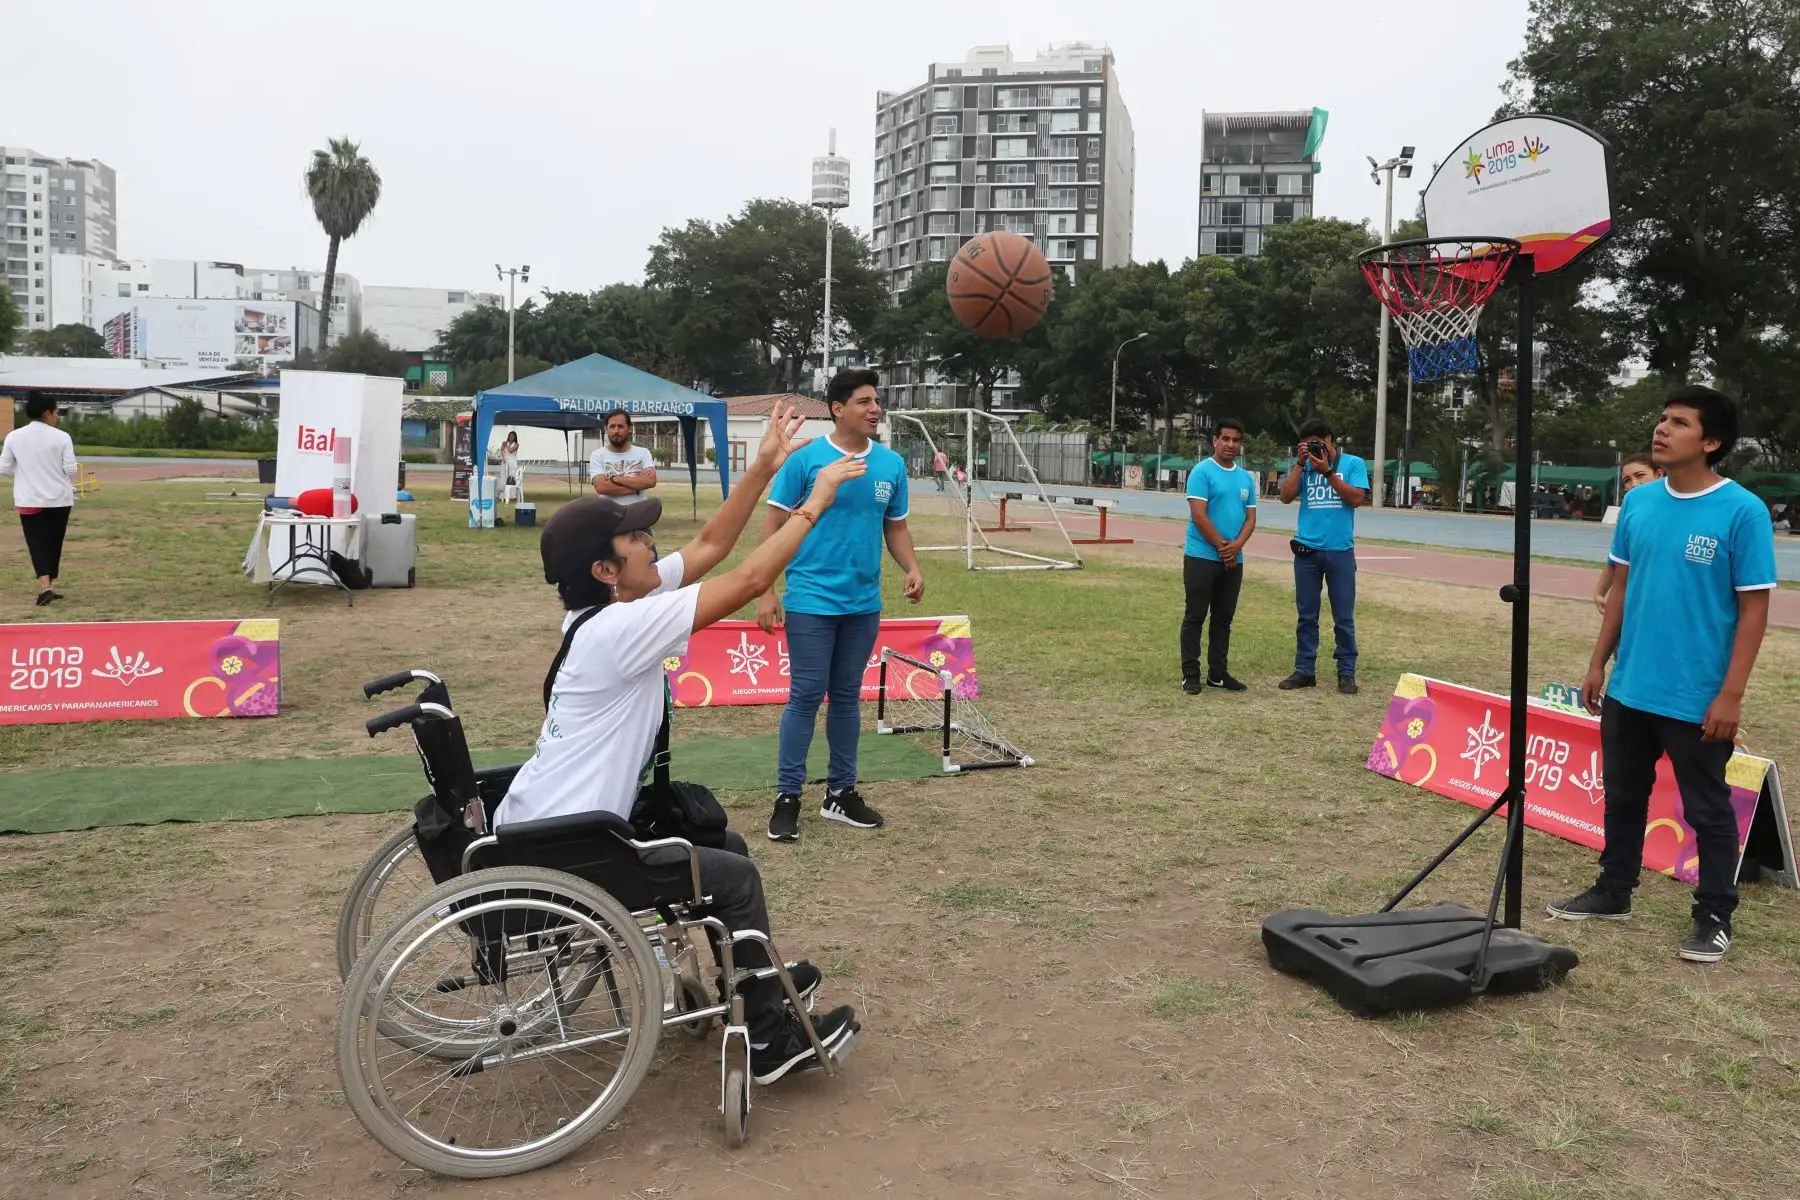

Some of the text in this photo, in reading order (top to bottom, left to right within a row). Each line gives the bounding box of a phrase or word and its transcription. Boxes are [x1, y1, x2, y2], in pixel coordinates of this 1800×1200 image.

[1488, 154, 1517, 175] 2019
[559, 398, 694, 415] IPALIDAD DE BARRANCO
[1685, 543, 1715, 559] 2019
[9, 666, 83, 690] 2019
[0, 699, 159, 713] MERICANOS Y PARAPANAMERICANOS
[1448, 777, 1472, 790] JUEGOS
